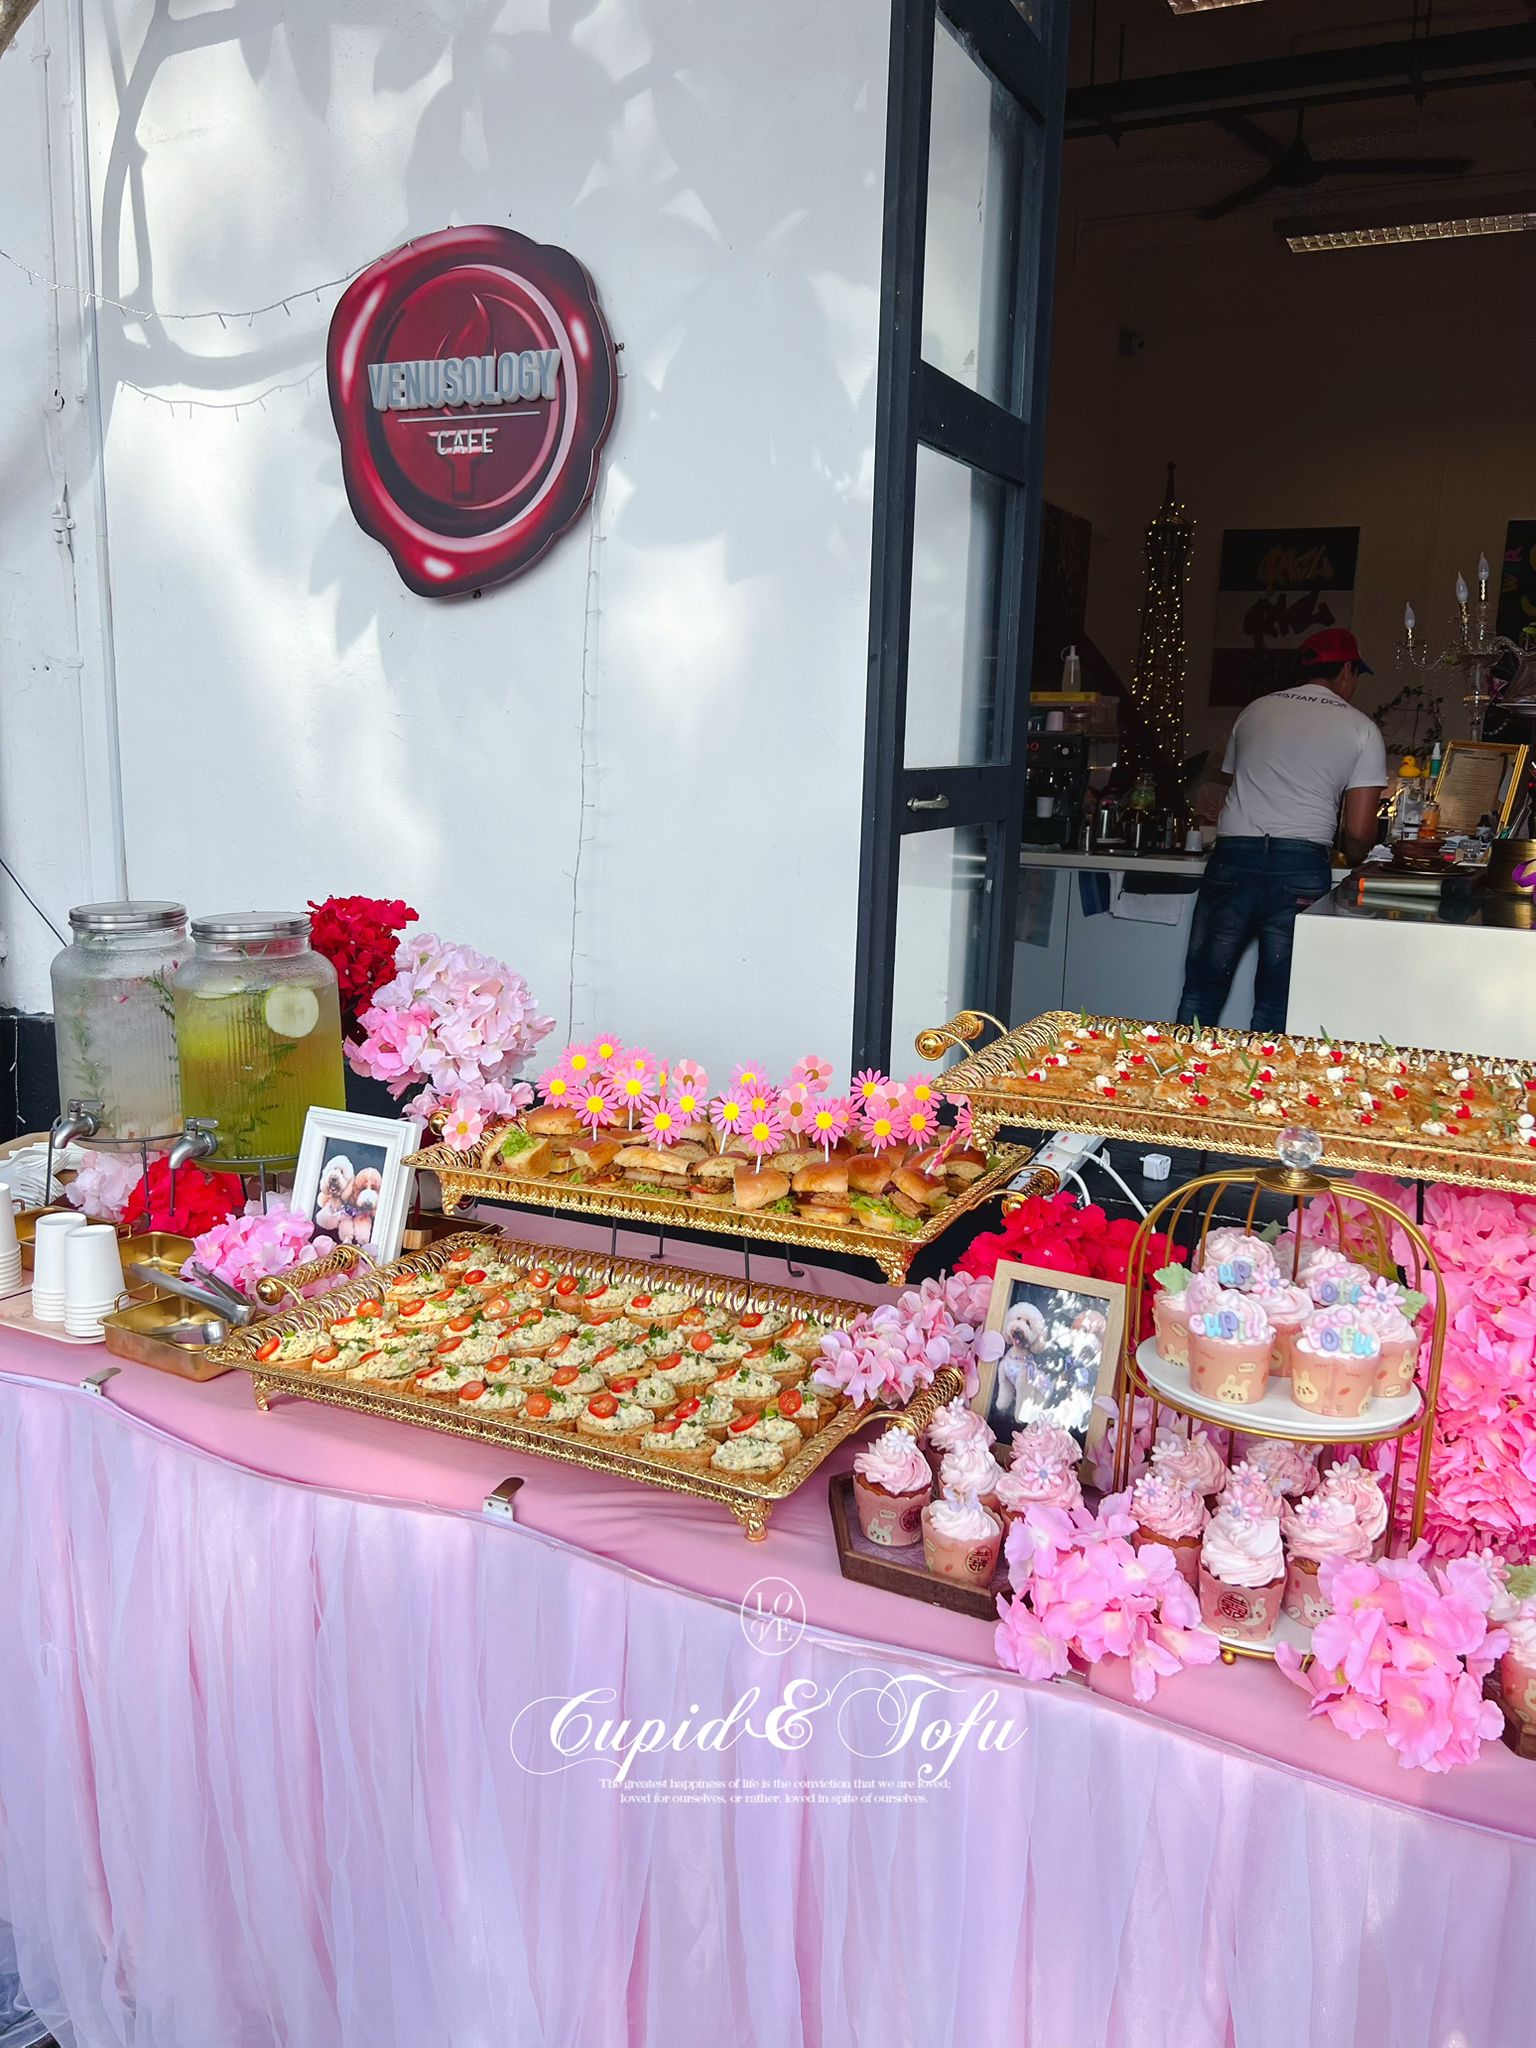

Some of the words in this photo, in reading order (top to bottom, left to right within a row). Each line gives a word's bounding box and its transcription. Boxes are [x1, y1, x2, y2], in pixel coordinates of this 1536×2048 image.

[368, 349, 561, 411] VENUSOLOGY
[436, 428, 494, 455] CAFE
[1320, 697, 1349, 711] DIOR
